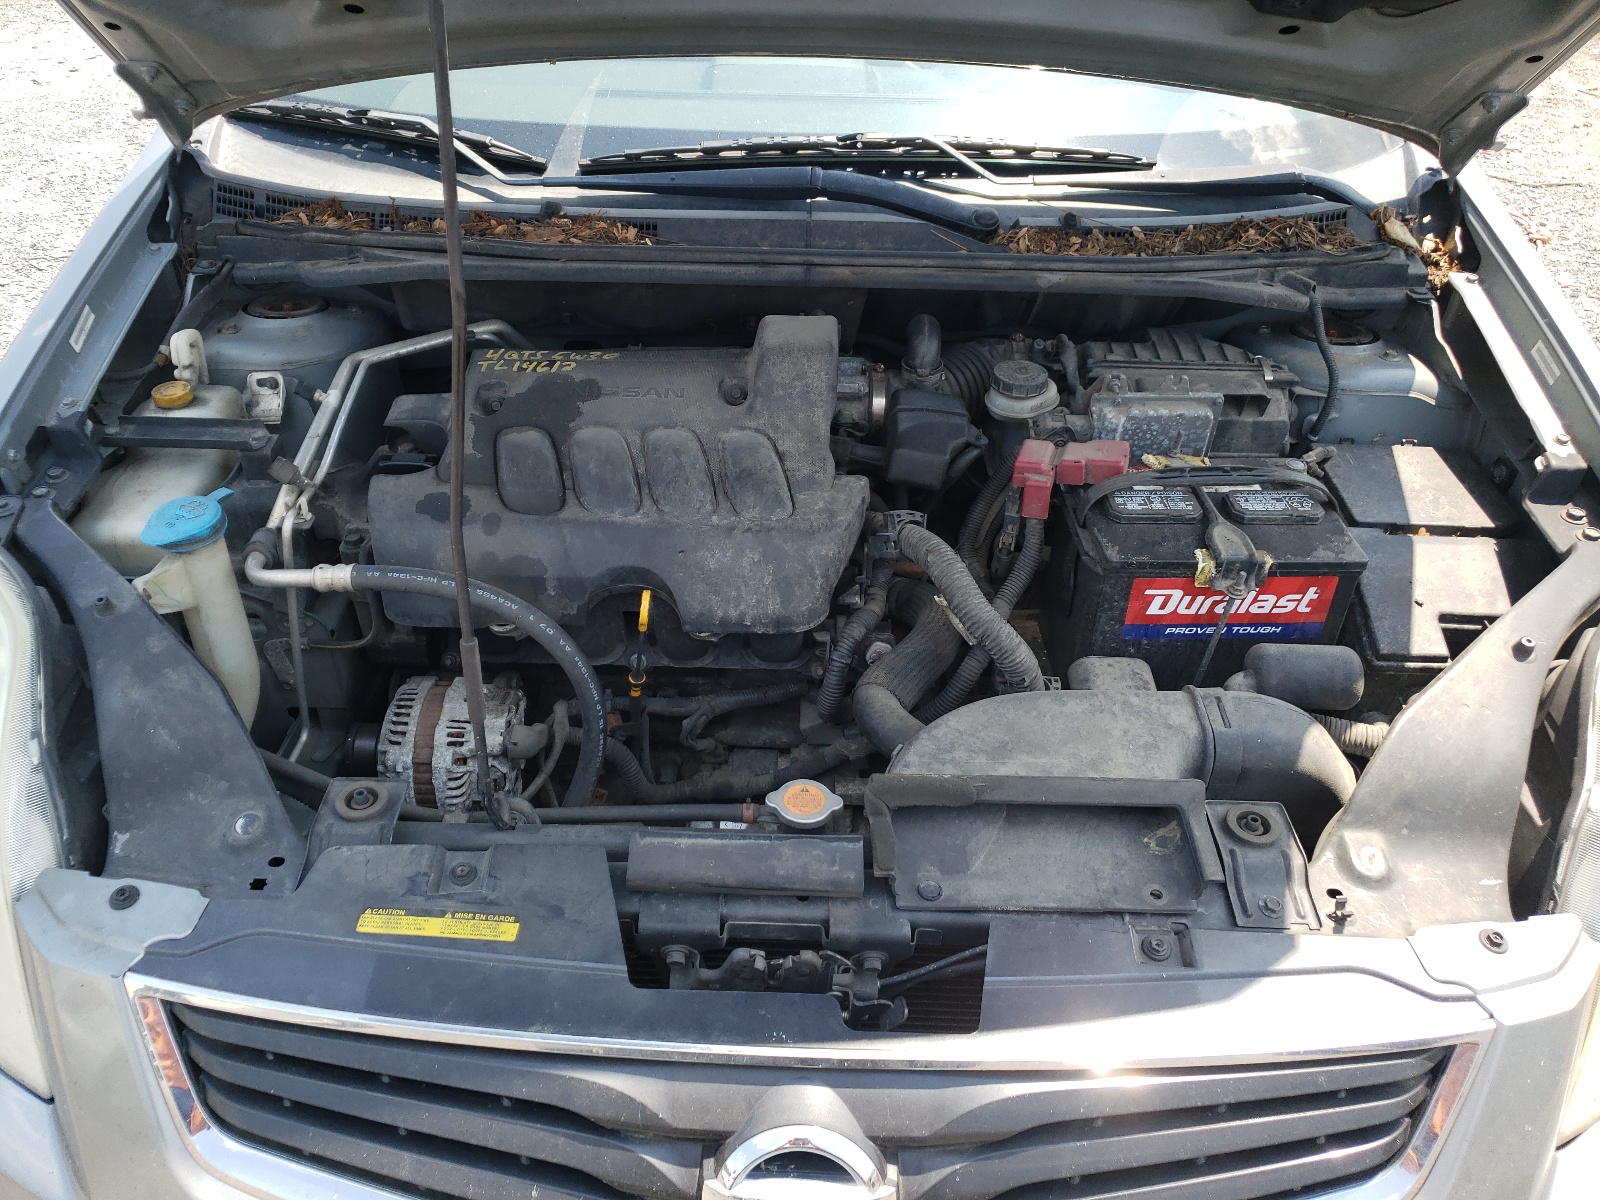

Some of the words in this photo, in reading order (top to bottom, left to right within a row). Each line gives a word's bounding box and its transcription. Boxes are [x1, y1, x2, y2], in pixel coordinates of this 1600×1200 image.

[571, 386, 686, 399] NSSAN
[1144, 586, 1320, 615] Duralast
[1232, 626, 1282, 634] TOUGH
[372, 908, 406, 916] CAUTION
